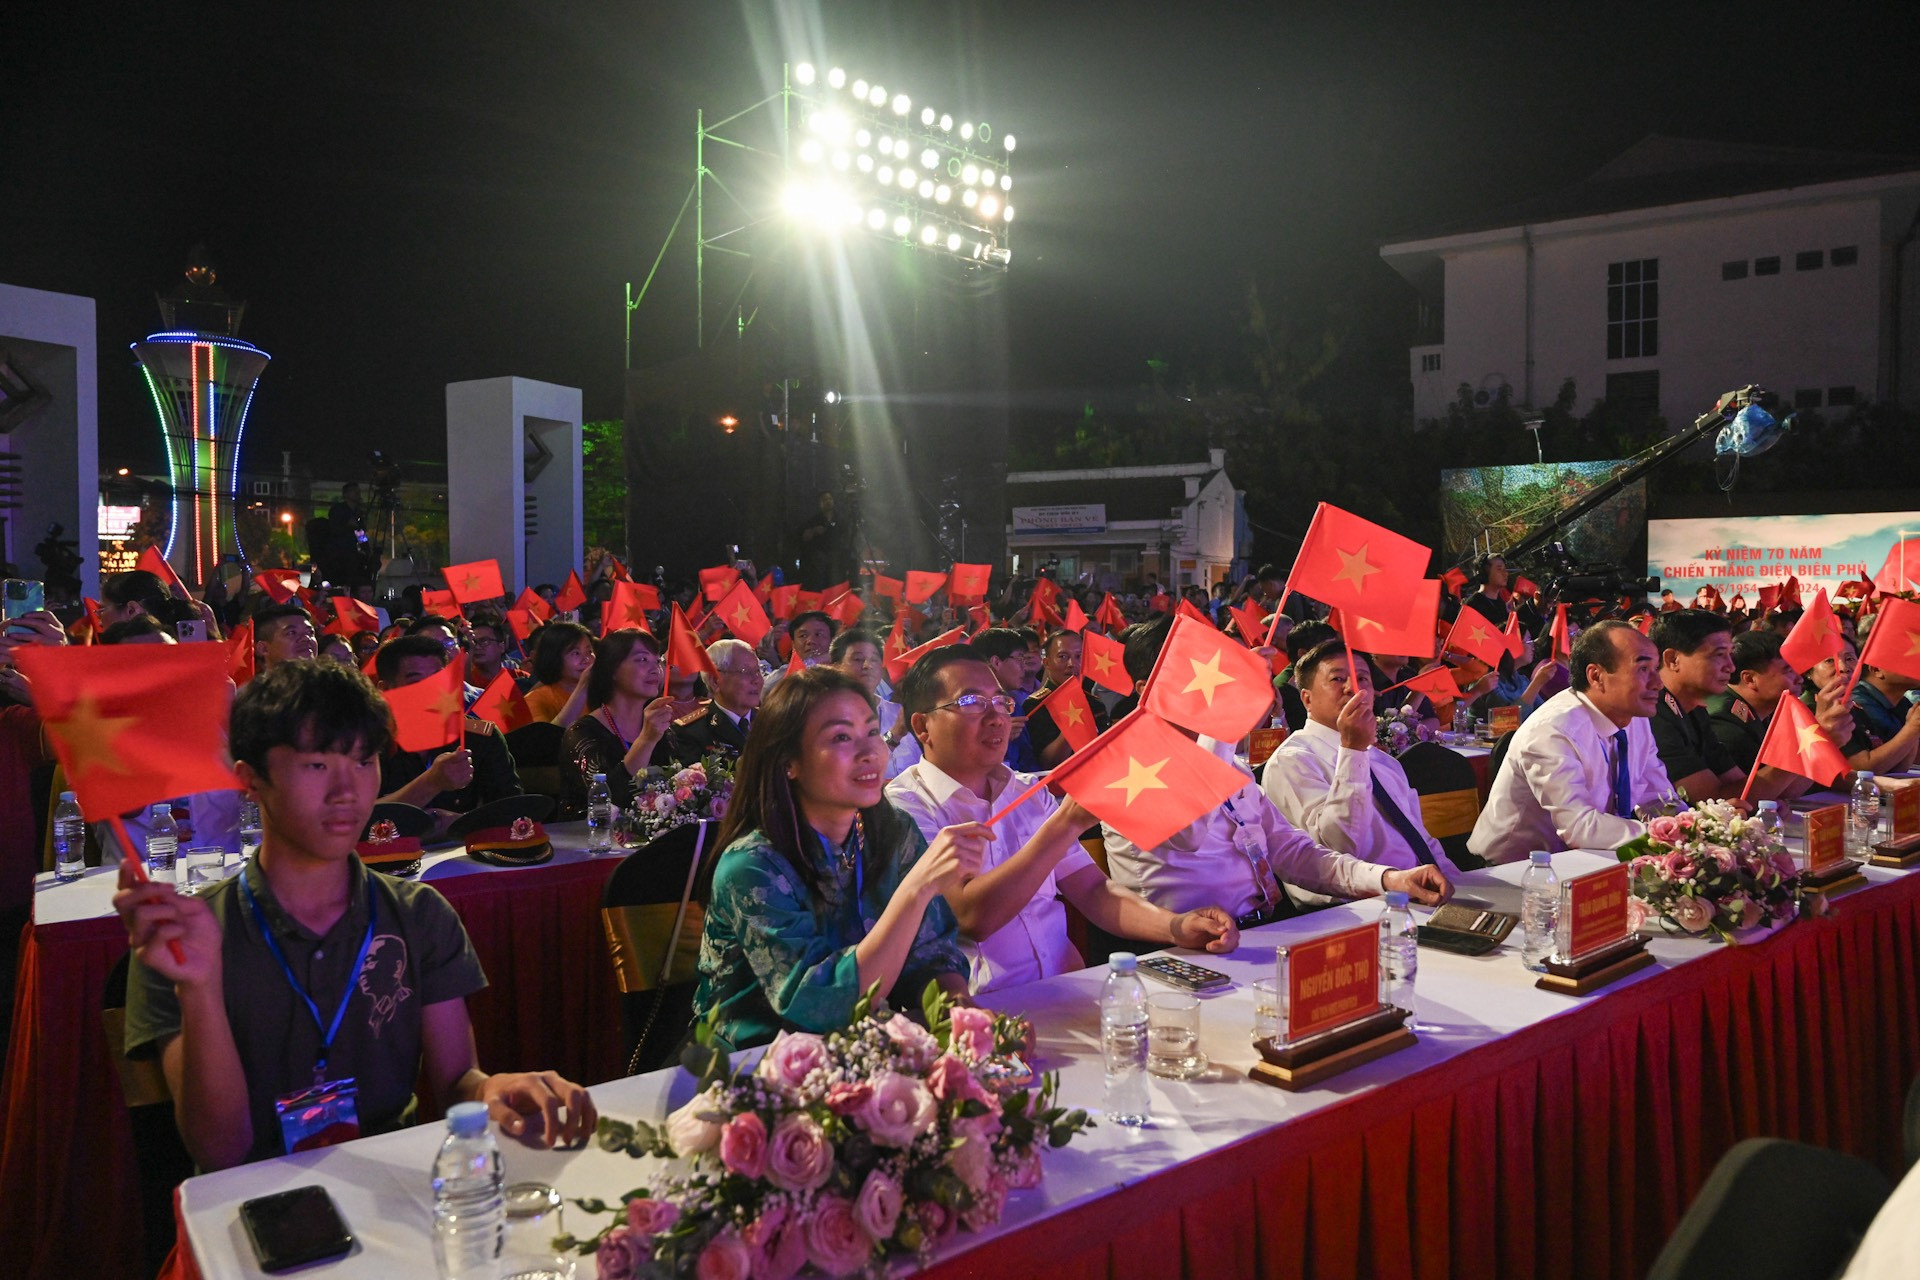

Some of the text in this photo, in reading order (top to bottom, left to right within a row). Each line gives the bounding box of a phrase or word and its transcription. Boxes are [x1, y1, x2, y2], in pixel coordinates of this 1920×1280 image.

[1705, 546, 1822, 561] KỶ NIỆM 70 NĂM
[1664, 561, 1867, 579] CHIẾN THẮNG ĐIỆN BIÊN PHỦ
[1300, 964, 1333, 1000] NGUYỄN
